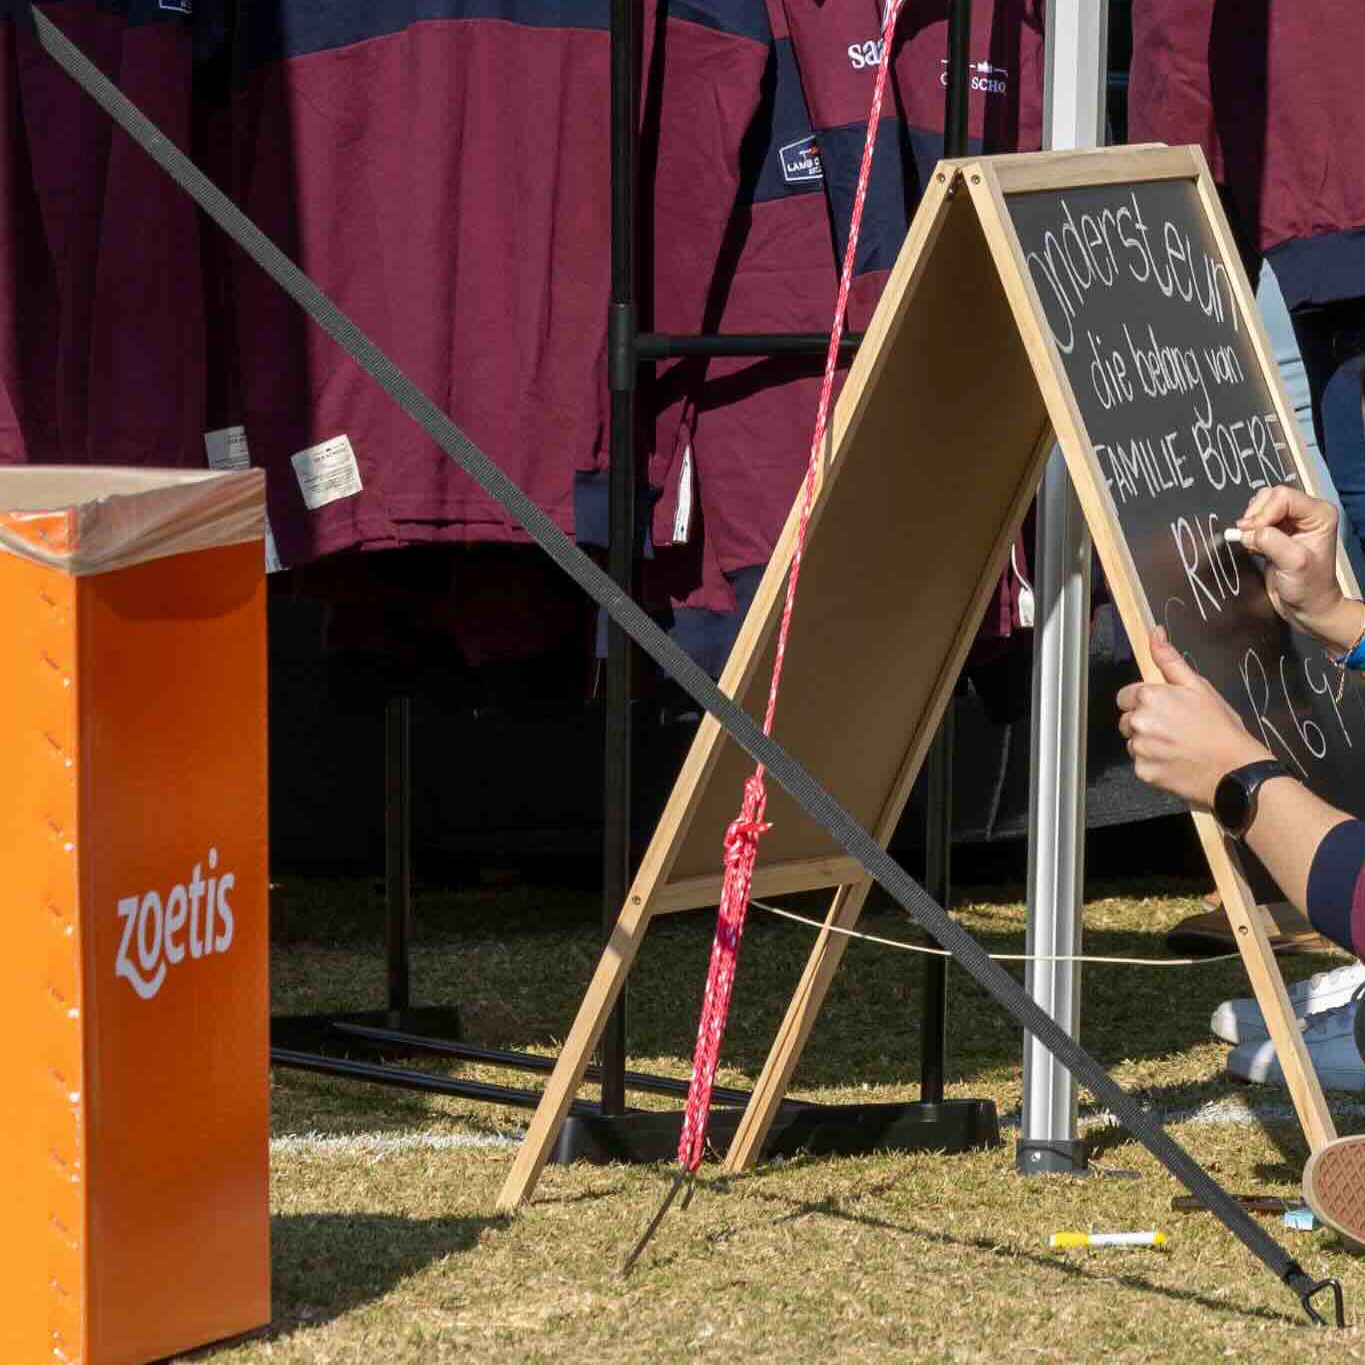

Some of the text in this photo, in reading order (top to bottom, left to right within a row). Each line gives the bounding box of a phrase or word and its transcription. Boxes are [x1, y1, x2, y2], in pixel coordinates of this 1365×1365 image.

[848, 38, 883, 69] sa
[1087, 324, 1244, 429] die belang van
[115, 847, 236, 999] zoetis
